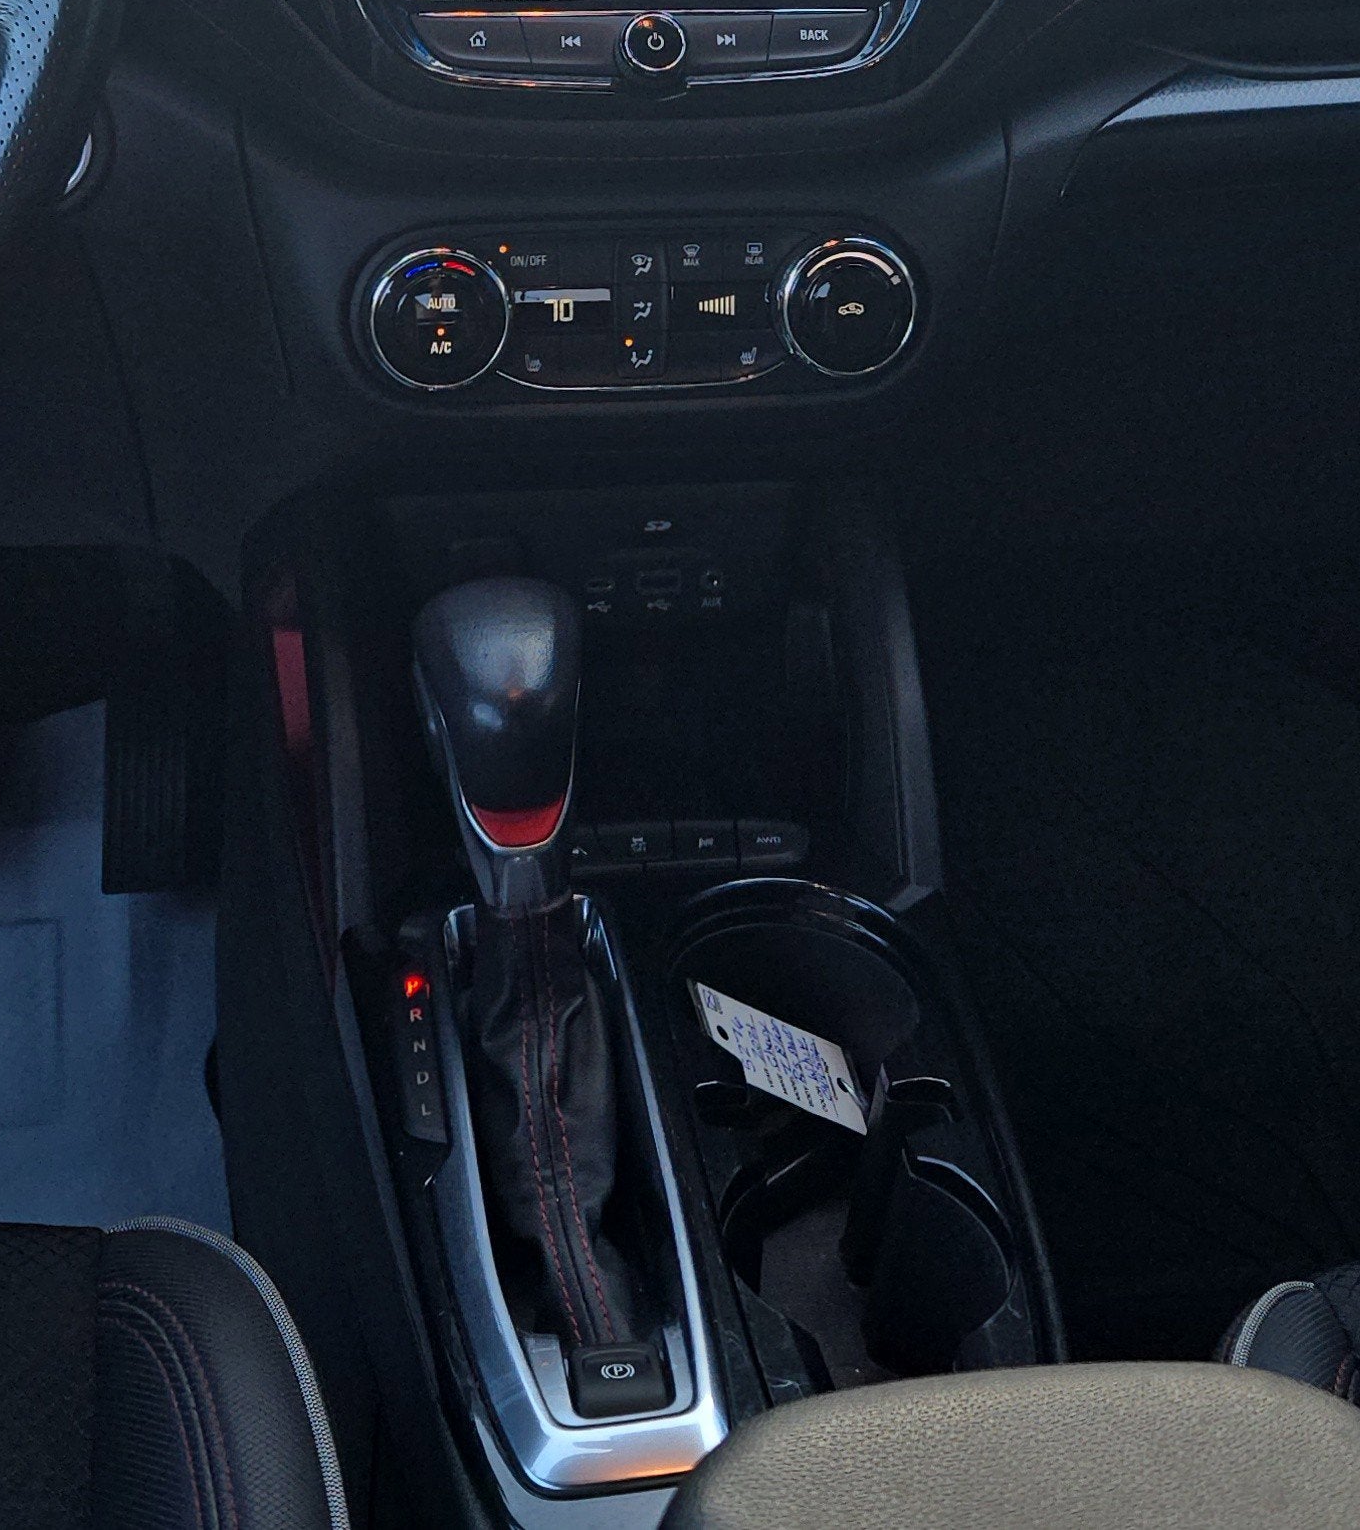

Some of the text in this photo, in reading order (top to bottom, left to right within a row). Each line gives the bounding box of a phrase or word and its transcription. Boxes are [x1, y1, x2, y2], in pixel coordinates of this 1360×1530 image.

[799, 28, 830, 42] BACK
[509, 254, 548, 268] ON/OFF
[426, 296, 457, 310] AUTO
[544, 298, 575, 323] 70
[429, 341, 453, 355] A/C
[409, 1007, 423, 1023] R
[413, 1038, 427, 1053] N
[416, 1071, 430, 1086] D
[421, 1103, 432, 1117] L
